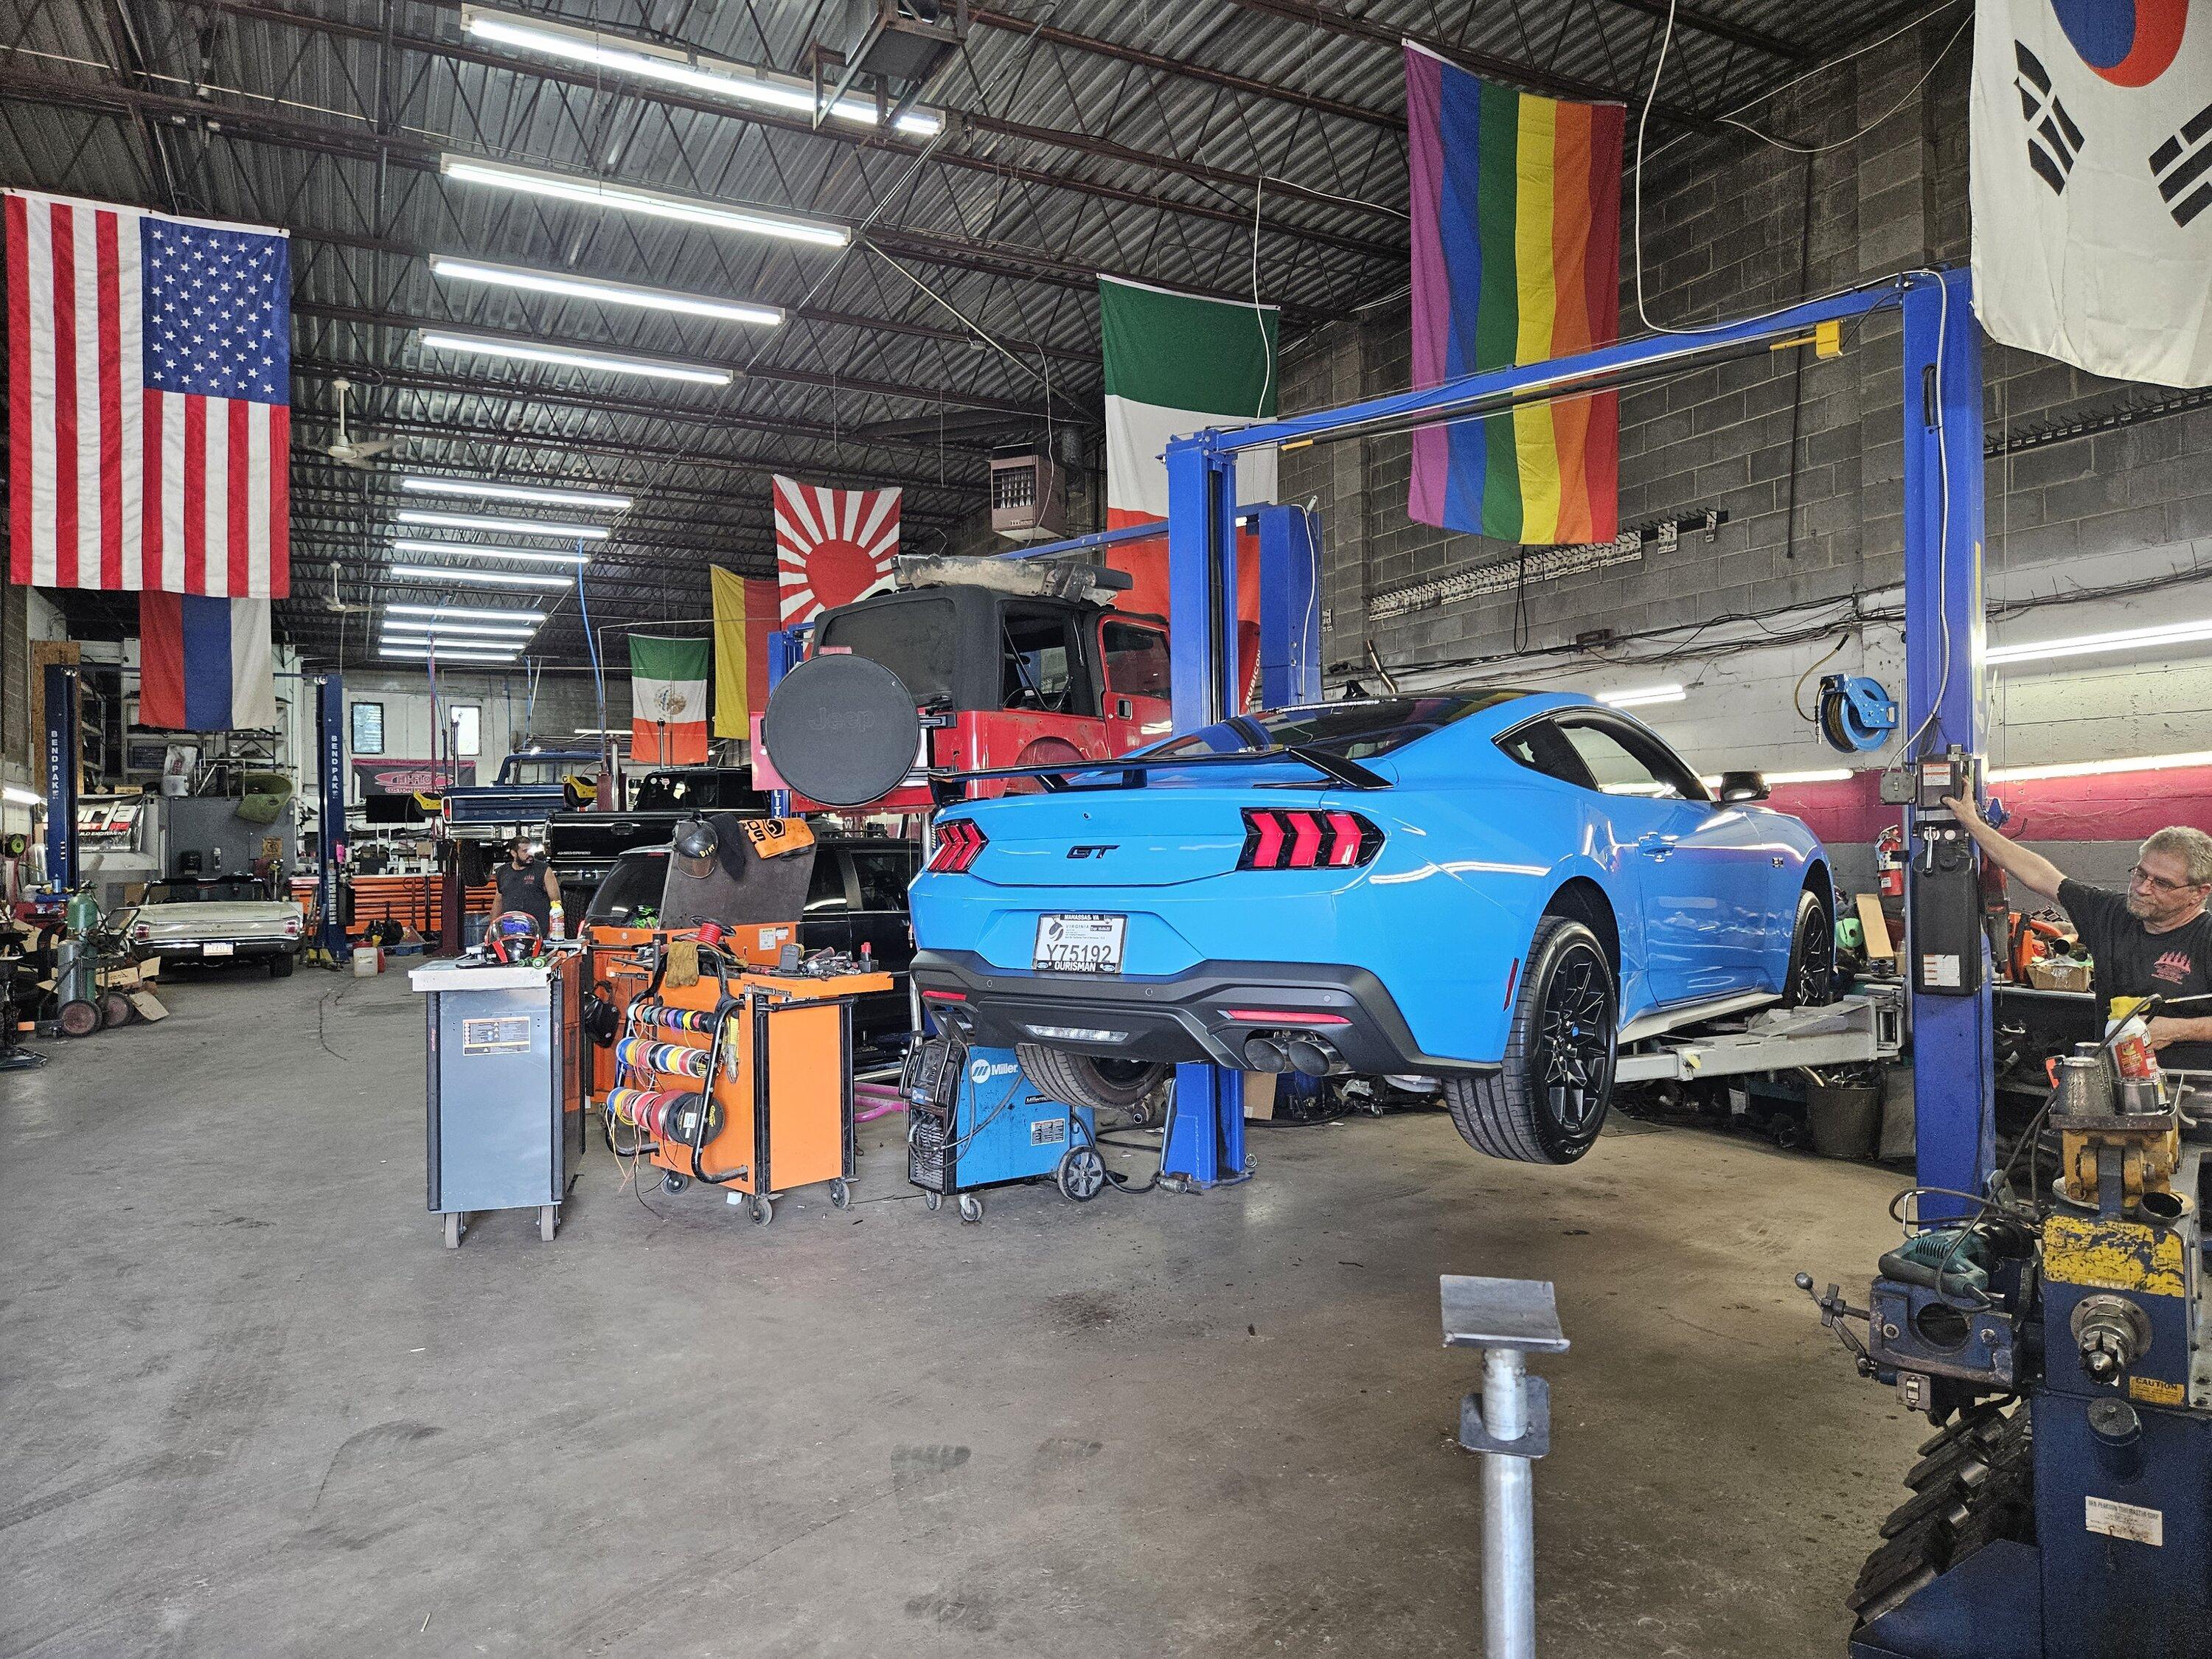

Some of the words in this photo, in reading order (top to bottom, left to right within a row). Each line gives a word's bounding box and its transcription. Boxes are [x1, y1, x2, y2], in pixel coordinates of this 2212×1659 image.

[1245, 650, 1261, 706] RUBICON
[1066, 845, 1121, 859] GT
[1046, 944, 1112, 963] Y75192
[1054, 961, 1096, 973] OURISMAN
[991, 1062, 1019, 1075] Miller
[2135, 1377, 2178, 1391] CAUTION
